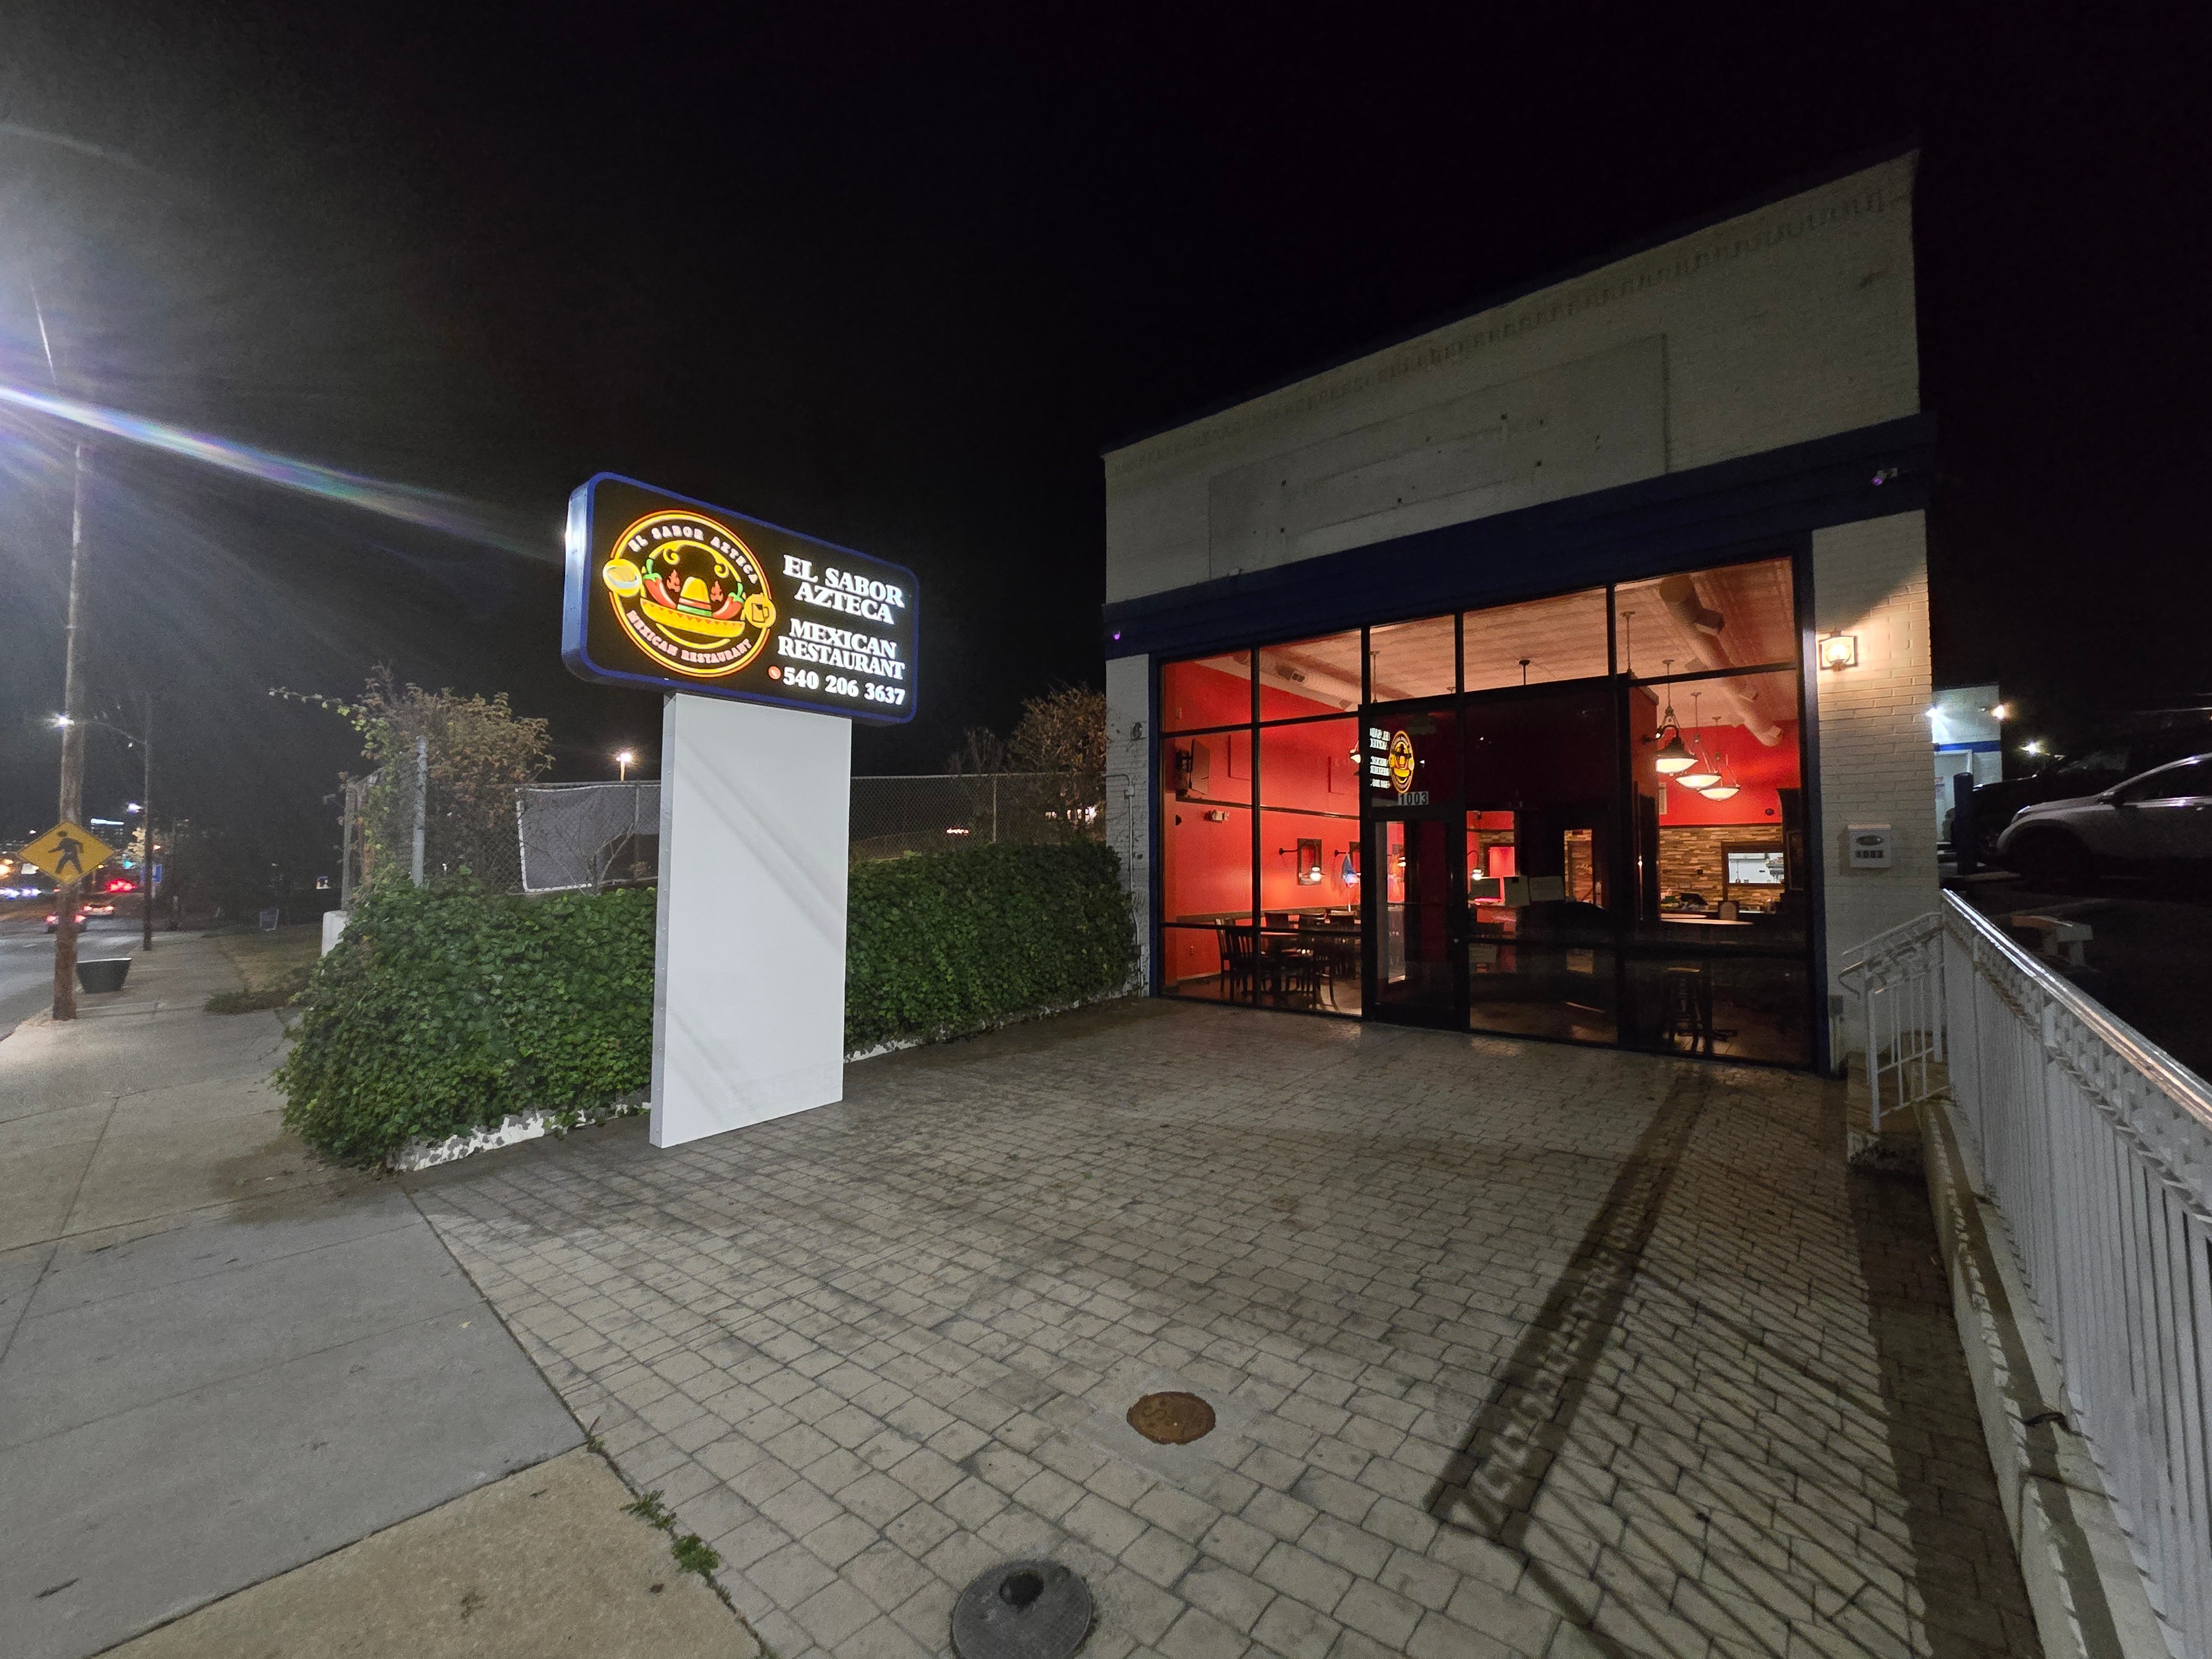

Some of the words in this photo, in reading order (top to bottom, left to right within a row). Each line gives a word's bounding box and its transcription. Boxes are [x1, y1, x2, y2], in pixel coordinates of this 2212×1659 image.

[651, 525, 704, 540] SABOR
[710, 536, 759, 584] AZTECA
[782, 554, 818, 583] EL
[825, 567, 905, 608] SABOR
[794, 582, 894, 624] AZTECA
[626, 610, 679, 656] MEXICAN
[681, 638, 752, 664] RESTAURANT
[778, 635, 905, 680] RESTAURANT
[789, 618, 897, 660] MEXICAN
[783, 666, 820, 690] 540
[825, 675, 859, 697] 206
[864, 682, 906, 705] 3637
[1399, 792, 1427, 805] 1003
